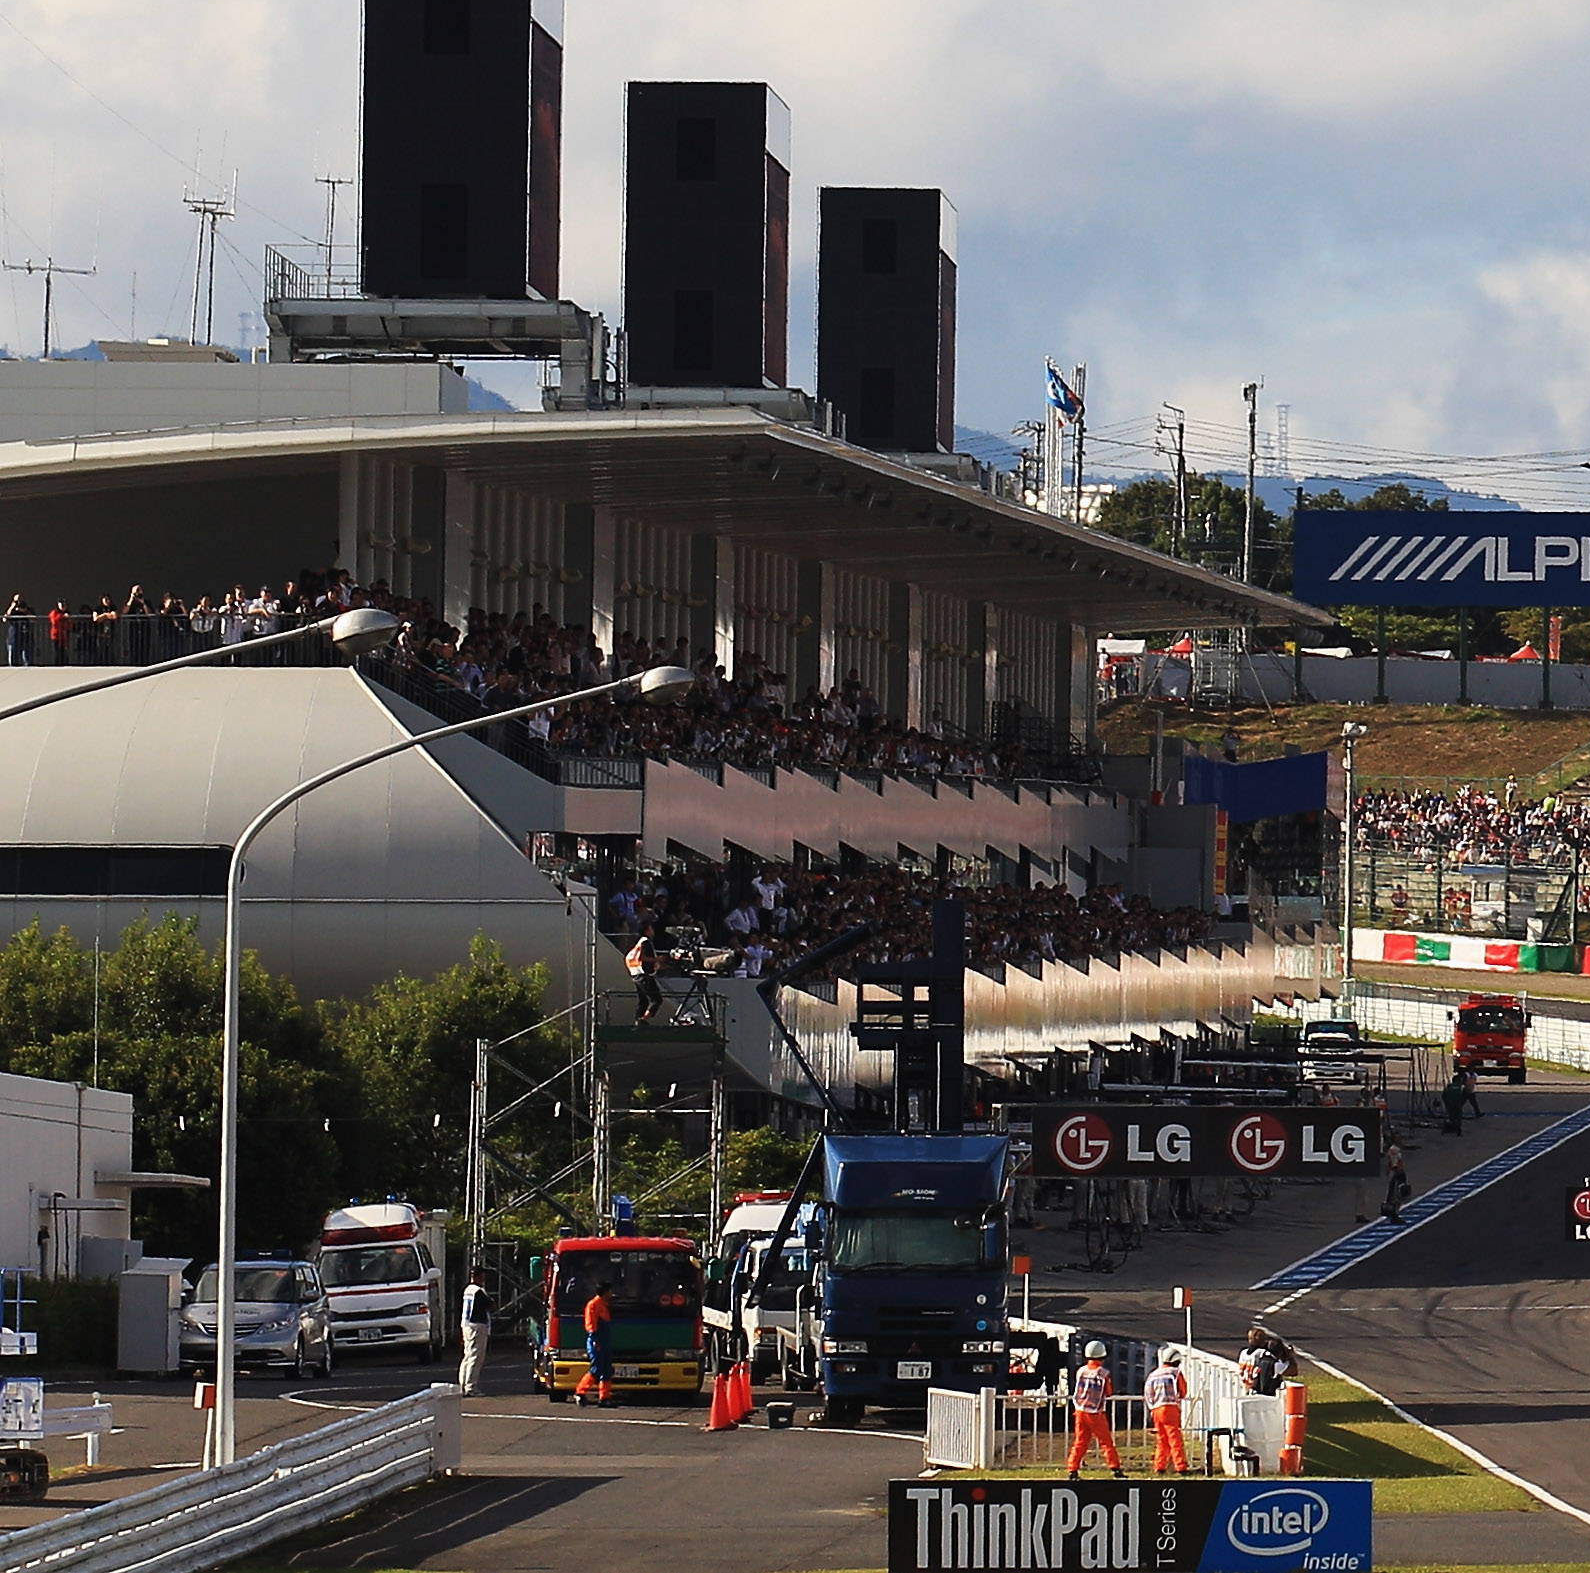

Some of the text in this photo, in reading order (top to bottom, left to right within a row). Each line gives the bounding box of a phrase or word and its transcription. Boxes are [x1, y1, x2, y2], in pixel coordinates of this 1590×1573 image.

[1127, 1124, 1191, 1163] LG
[1302, 1124, 1365, 1163] LG
[906, 1488, 1140, 1570] ThinkPad
[1156, 1488, 1177, 1568] T Series
[1241, 1502, 1312, 1536] intel
[1303, 1552, 1359, 1571] inside
